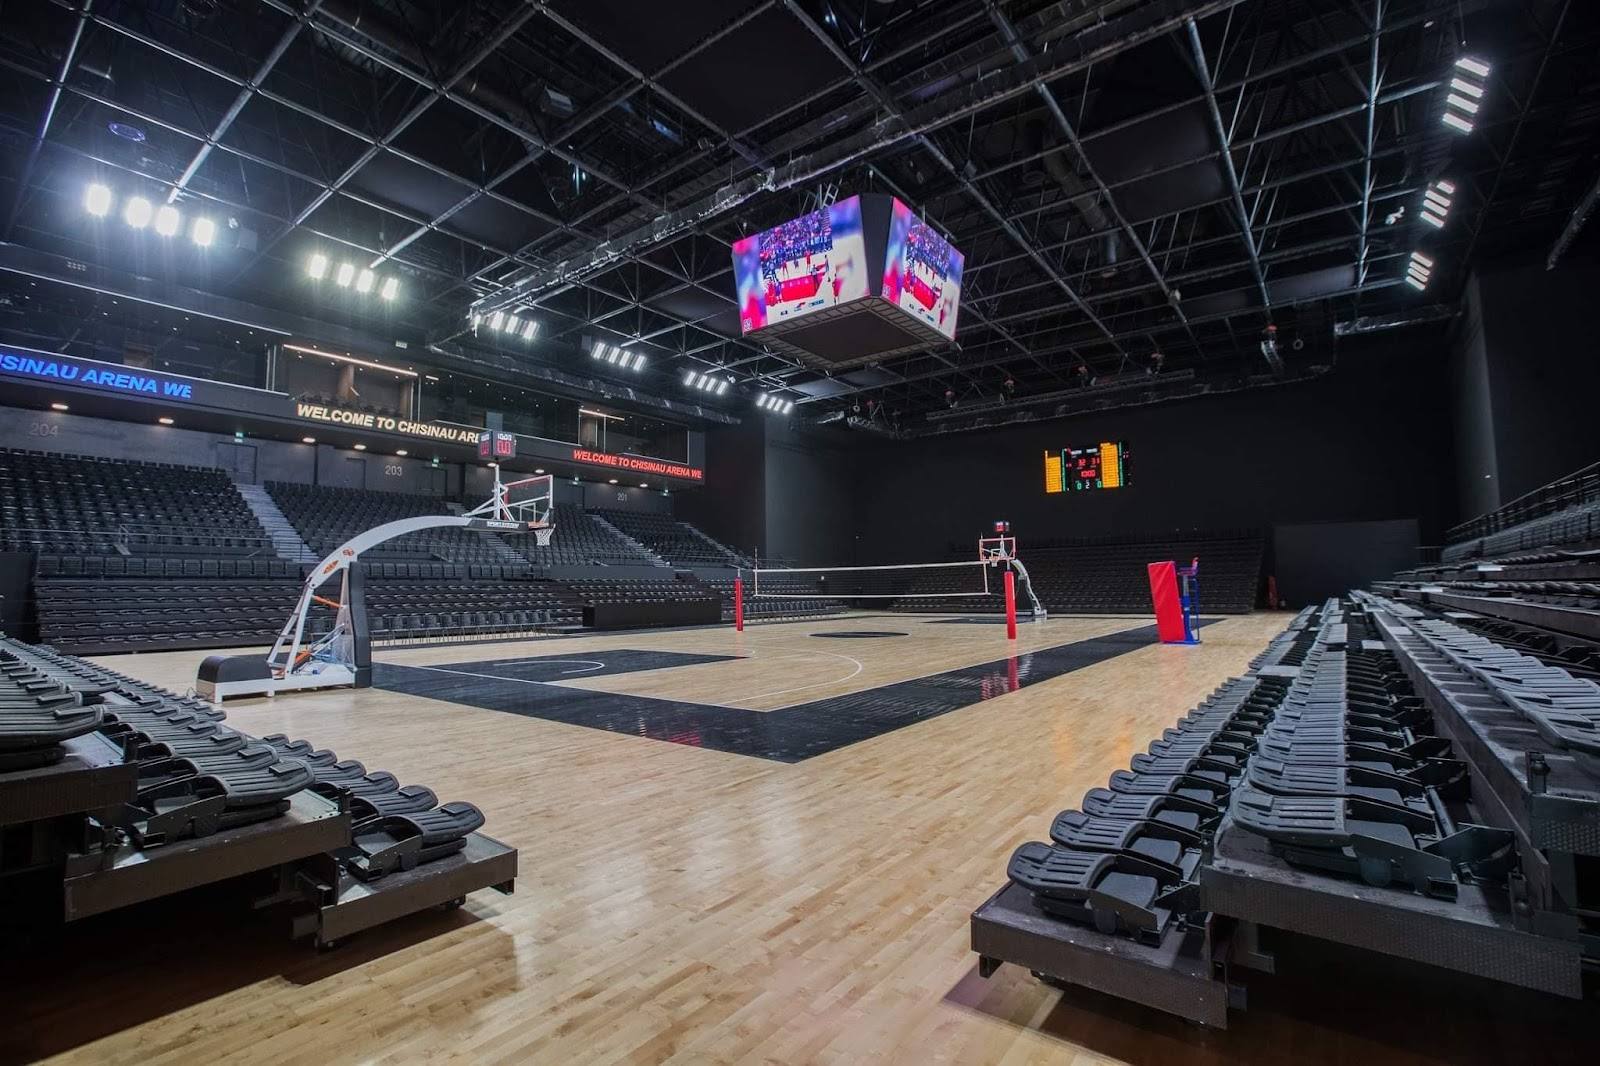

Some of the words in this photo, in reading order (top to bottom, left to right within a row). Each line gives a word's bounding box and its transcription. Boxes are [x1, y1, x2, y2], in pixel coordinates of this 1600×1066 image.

[81, 370, 157, 393] ARENA
[164, 381, 192, 399] WE
[30, 423, 58, 437] 204
[297, 403, 375, 427] WELCOME
[376, 417, 396, 430] TO
[398, 421, 457, 440] CHISINAU
[384, 464, 403, 477] 203
[573, 449, 617, 465] WELCOME
[618, 457, 630, 467] TO
[630, 460, 666, 473] CHISINAU
[666, 466, 690, 477] ARENA
[691, 469, 702, 479] WE
[617, 491, 628, 502] 201
